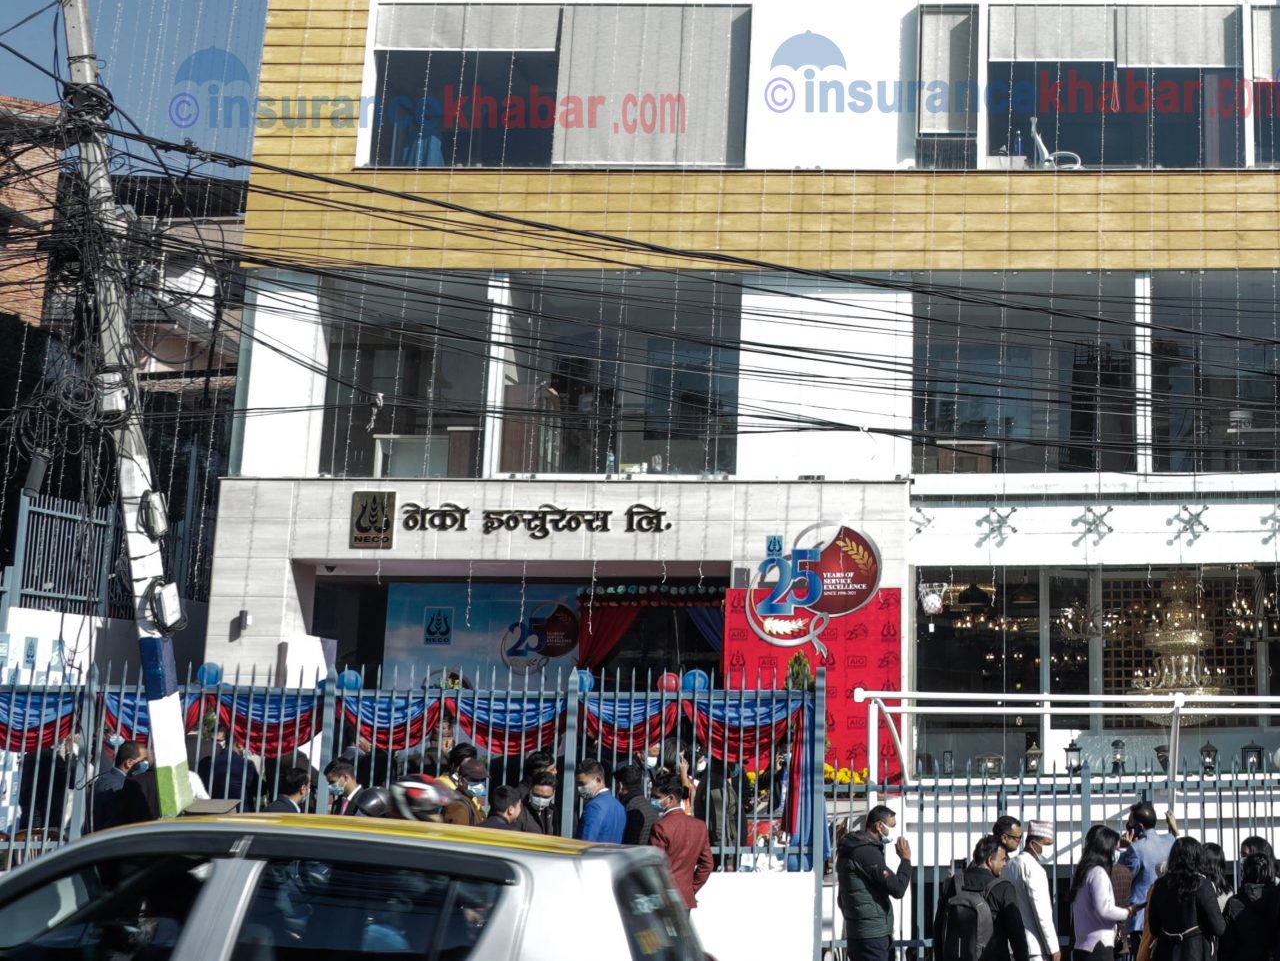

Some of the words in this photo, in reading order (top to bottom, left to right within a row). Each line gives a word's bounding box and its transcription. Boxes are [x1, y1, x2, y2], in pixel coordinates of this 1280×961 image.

[401, 502, 470, 532] नेको
[624, 503, 673, 533] लि.
[353, 535, 390, 543] NECO
[756, 549, 823, 616] 25
